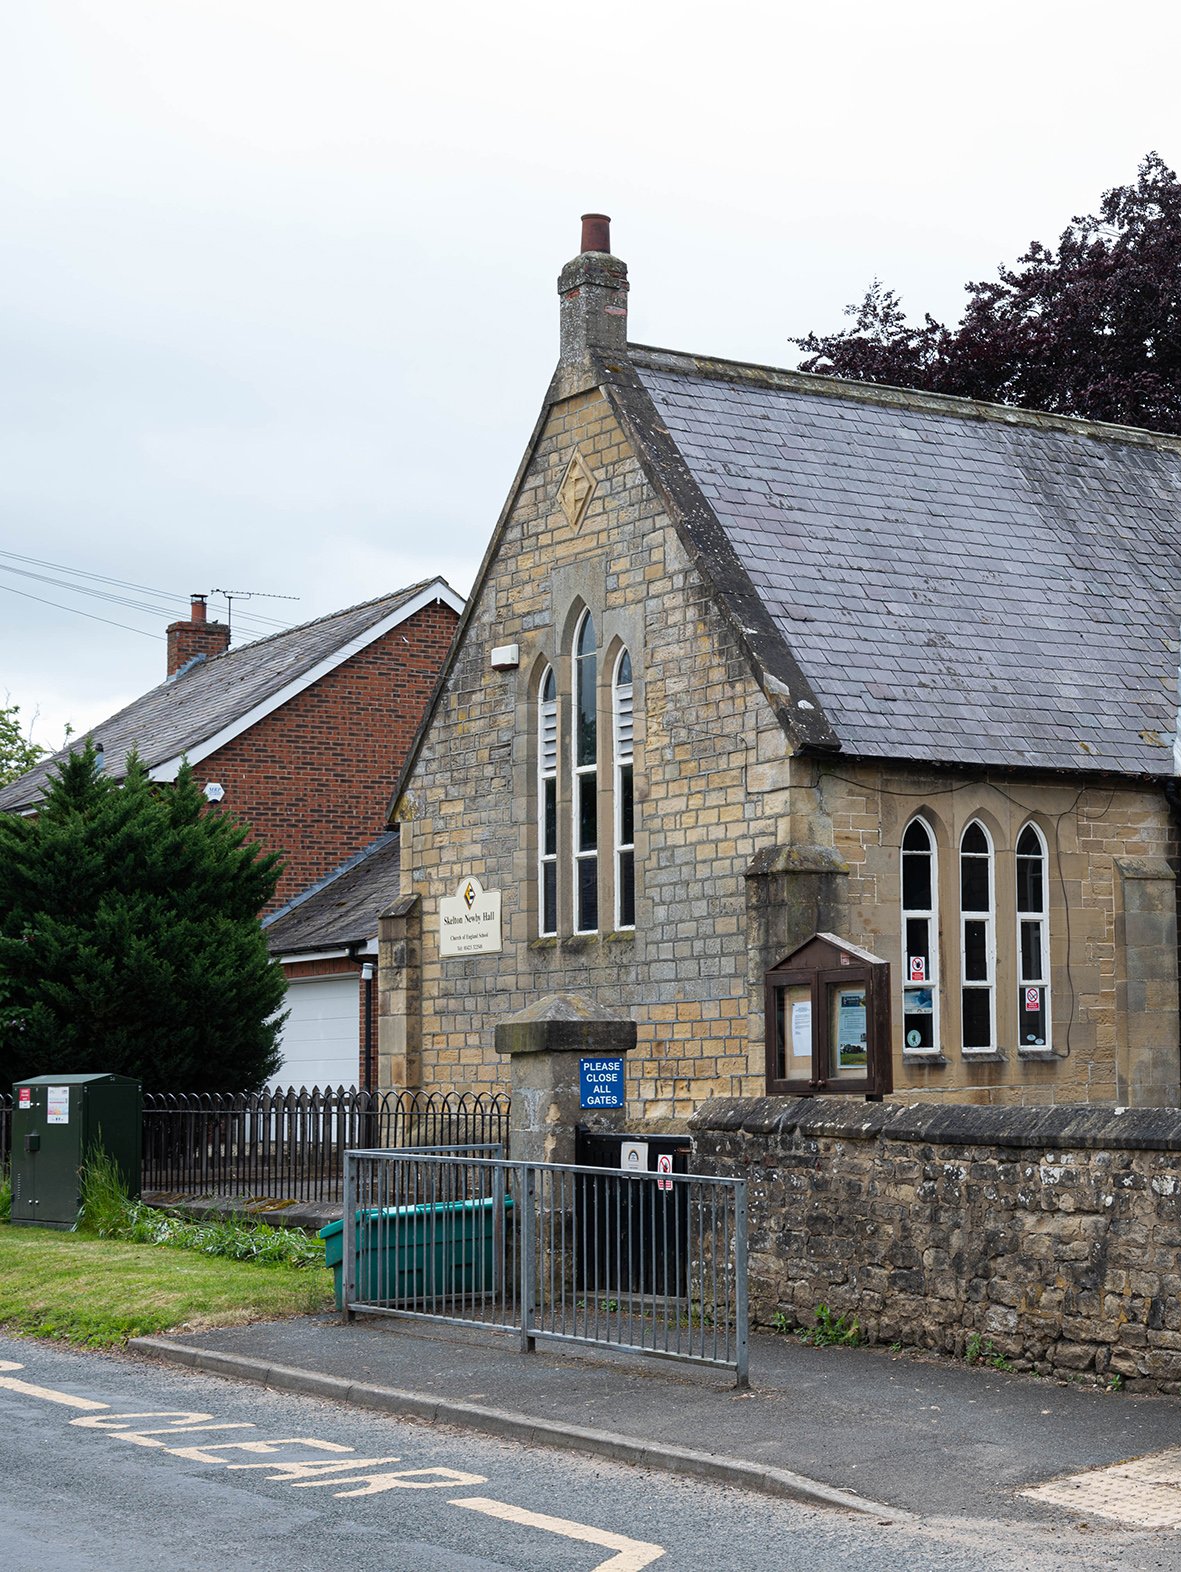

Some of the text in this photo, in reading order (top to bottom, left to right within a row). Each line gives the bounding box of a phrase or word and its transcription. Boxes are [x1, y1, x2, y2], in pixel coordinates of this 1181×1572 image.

[444, 912, 494, 925] Skelton Newby Hall
[583, 1062, 620, 1071] PLEASE
[586, 1073, 618, 1082] CLOSE
[593, 1085, 612, 1094] ALL
[587, 1096, 618, 1105] GATES
[69, 1411, 489, 1498] CLEAR
